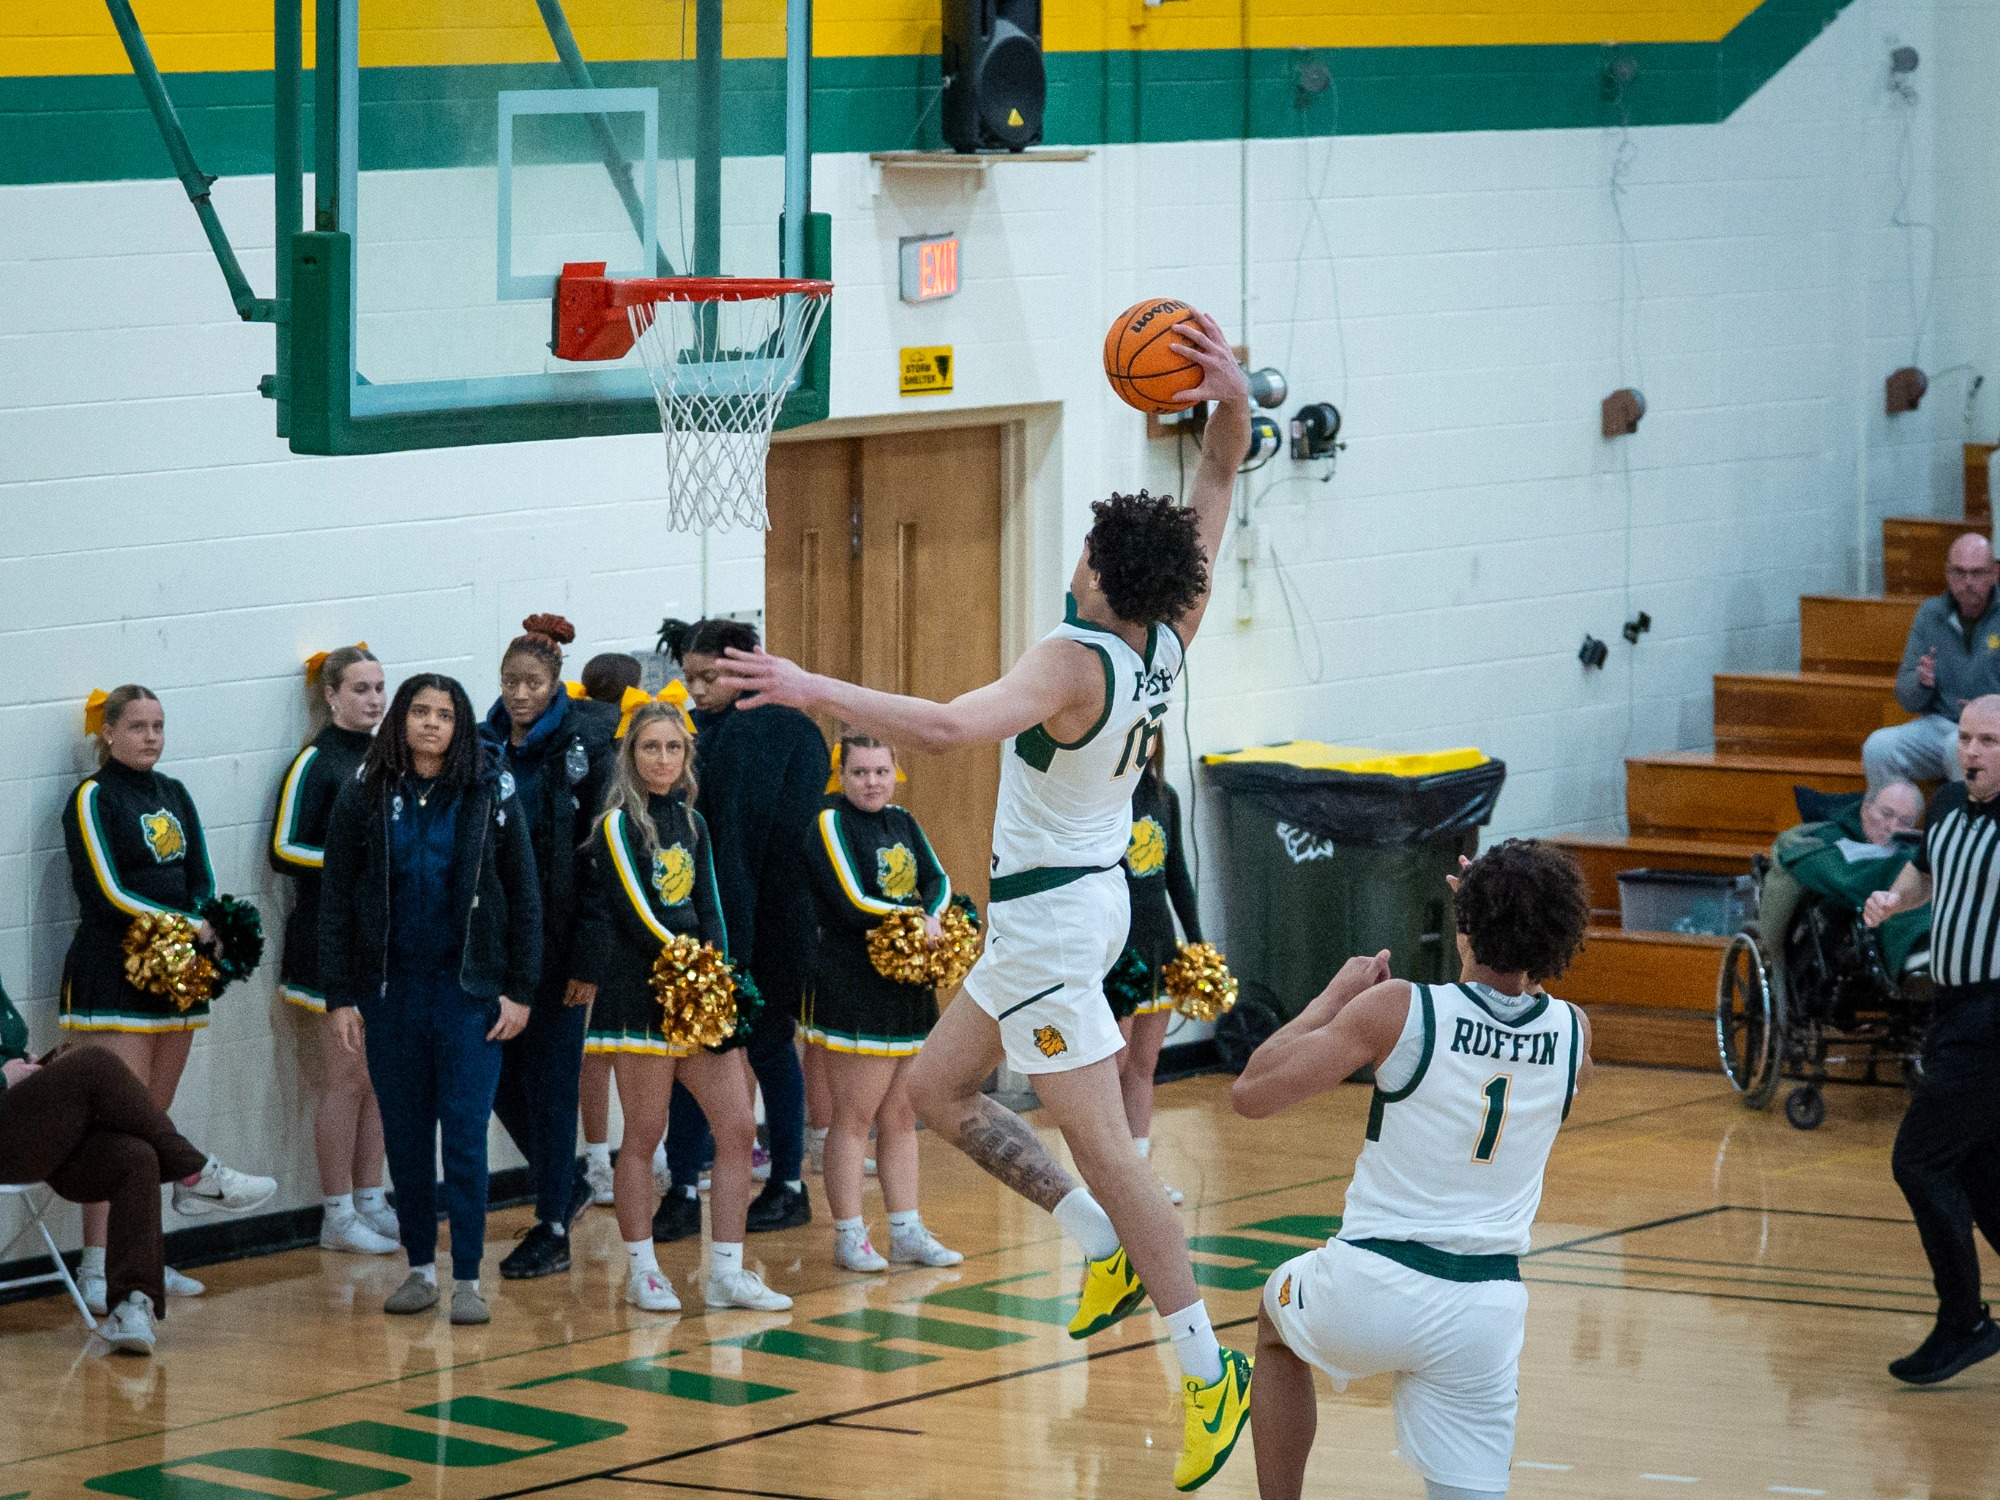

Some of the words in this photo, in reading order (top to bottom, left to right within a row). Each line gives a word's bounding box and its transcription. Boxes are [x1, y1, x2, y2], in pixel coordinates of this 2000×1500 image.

[921, 239, 958, 298] EXIT
[906, 363, 932, 374] STORM
[1451, 1017, 1558, 1065] RUFFIN
[1471, 1072, 1513, 1165] 1
